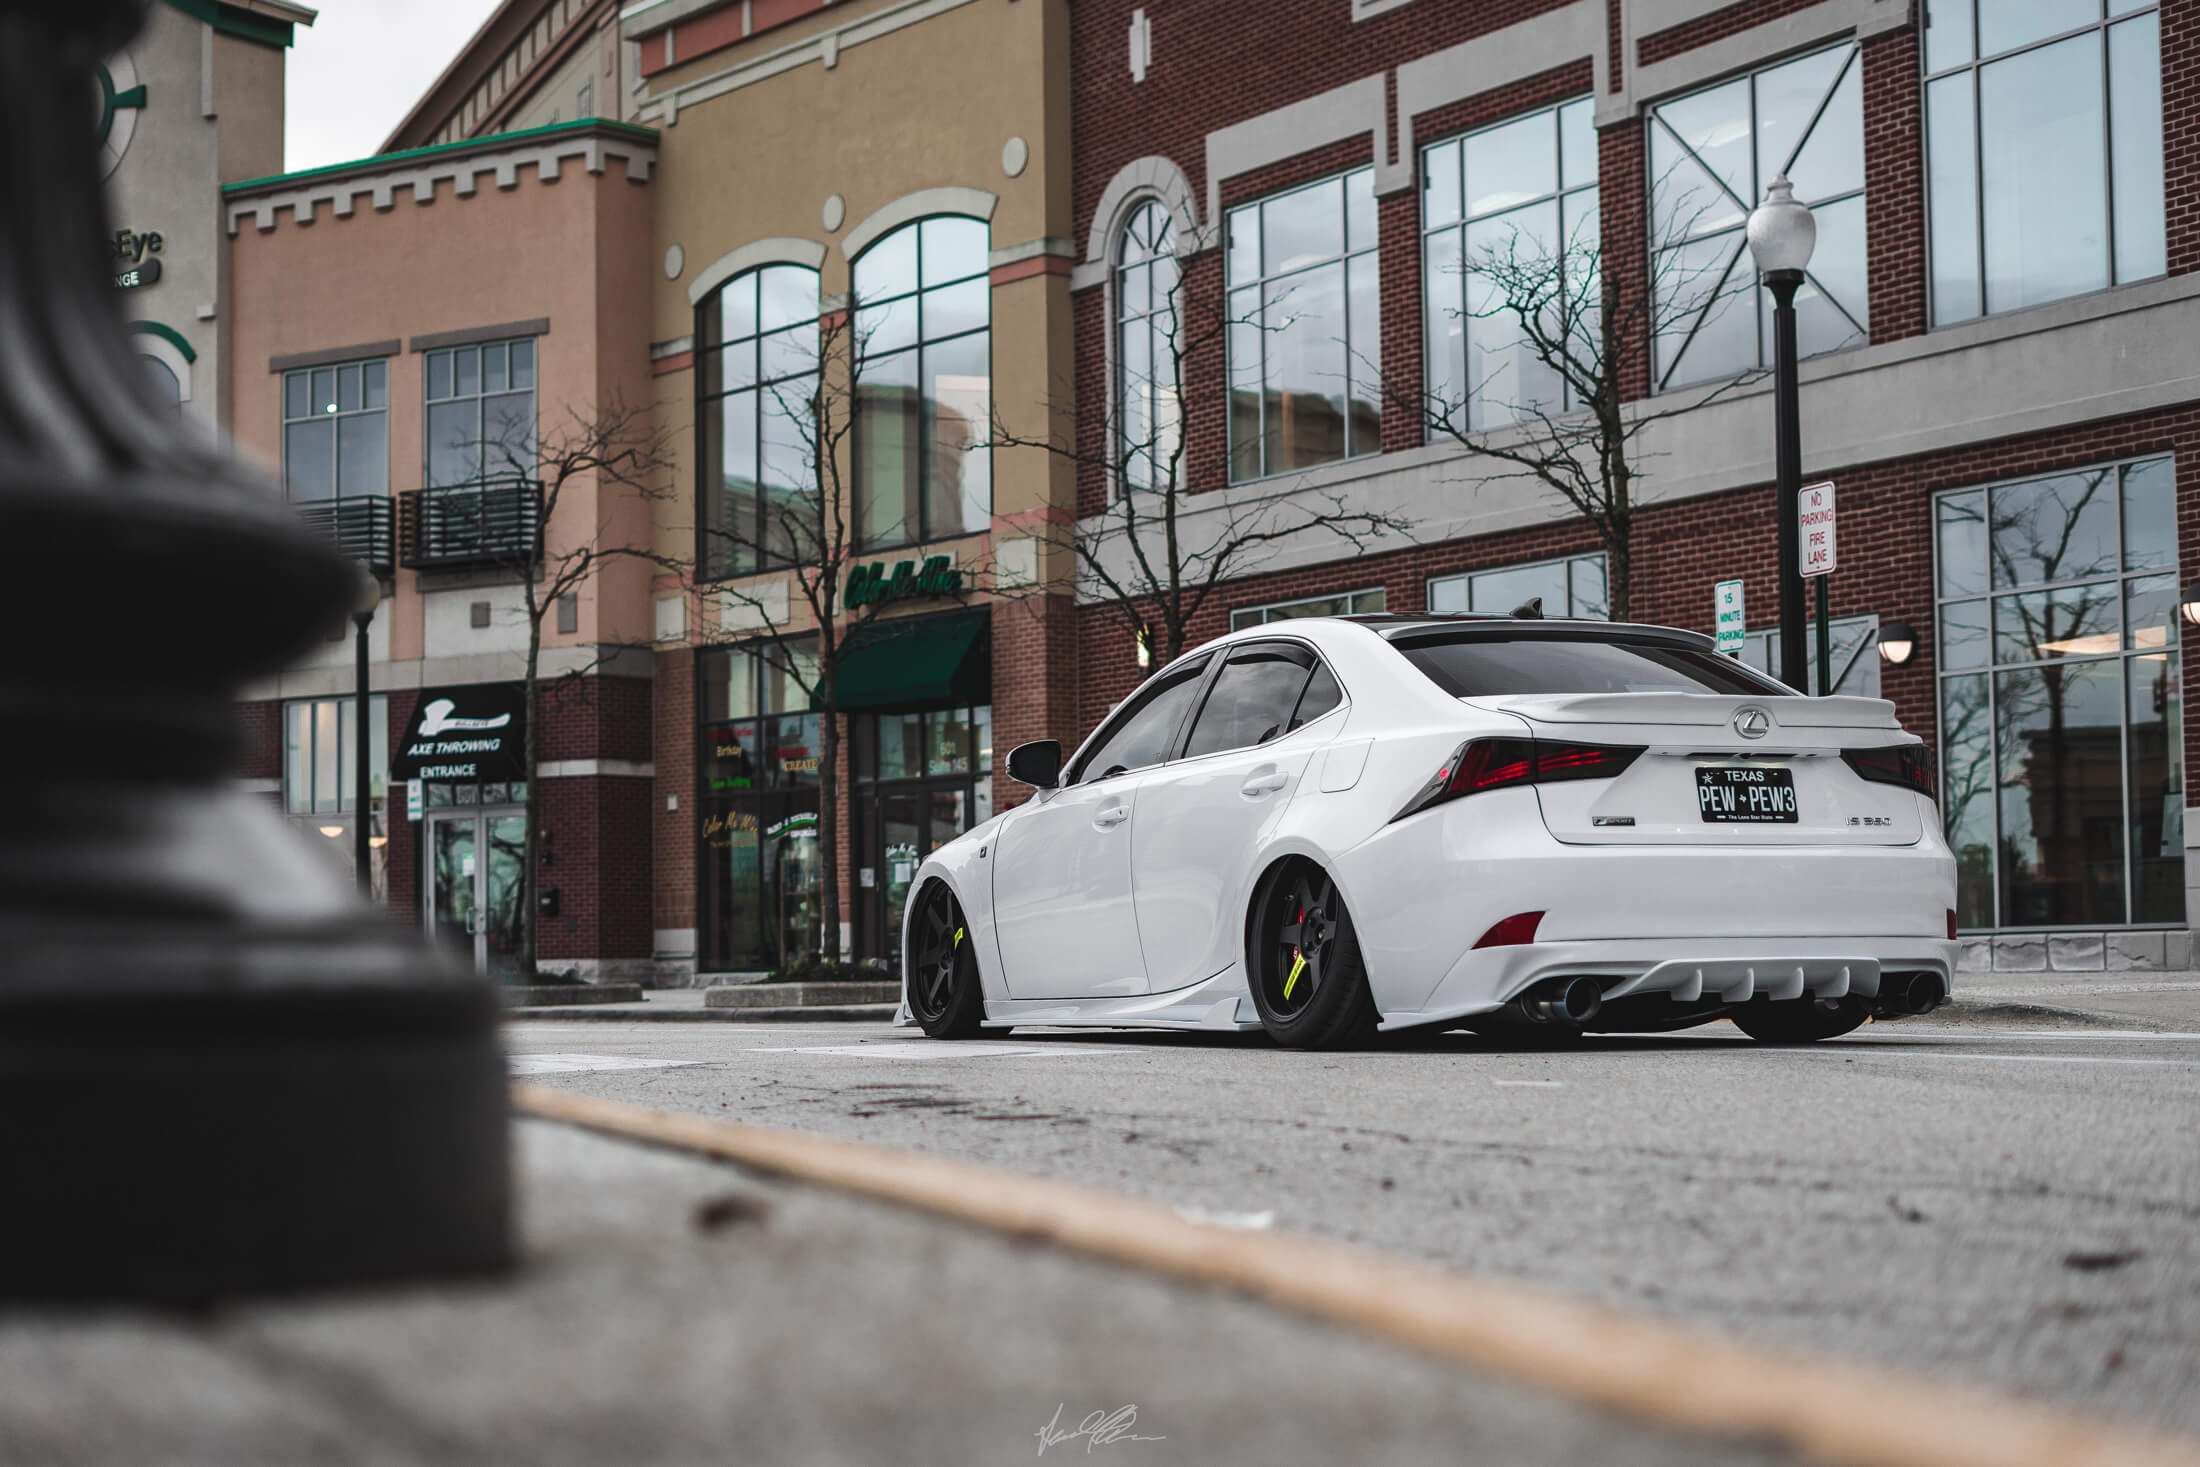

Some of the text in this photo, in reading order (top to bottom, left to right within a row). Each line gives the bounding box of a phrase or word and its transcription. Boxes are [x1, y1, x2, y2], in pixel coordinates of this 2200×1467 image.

[1811, 493, 1822, 507] NO
[1801, 509, 1833, 527] PARKING
[1809, 531, 1825, 547] FIRE
[1808, 549, 1827, 565] LANE
[1724, 592, 1733, 604] 15
[1720, 610, 1741, 623] MINUTE
[1718, 629, 1744, 643] PARKING
[407, 739, 501, 756] AXE THROWING
[420, 764, 477, 778] ENTRANCE
[784, 758, 817, 771] CREATE
[1724, 770, 1765, 782] TEXAS
[1699, 785, 1796, 812] PEW PEW3
[1863, 816, 1892, 826] 350
